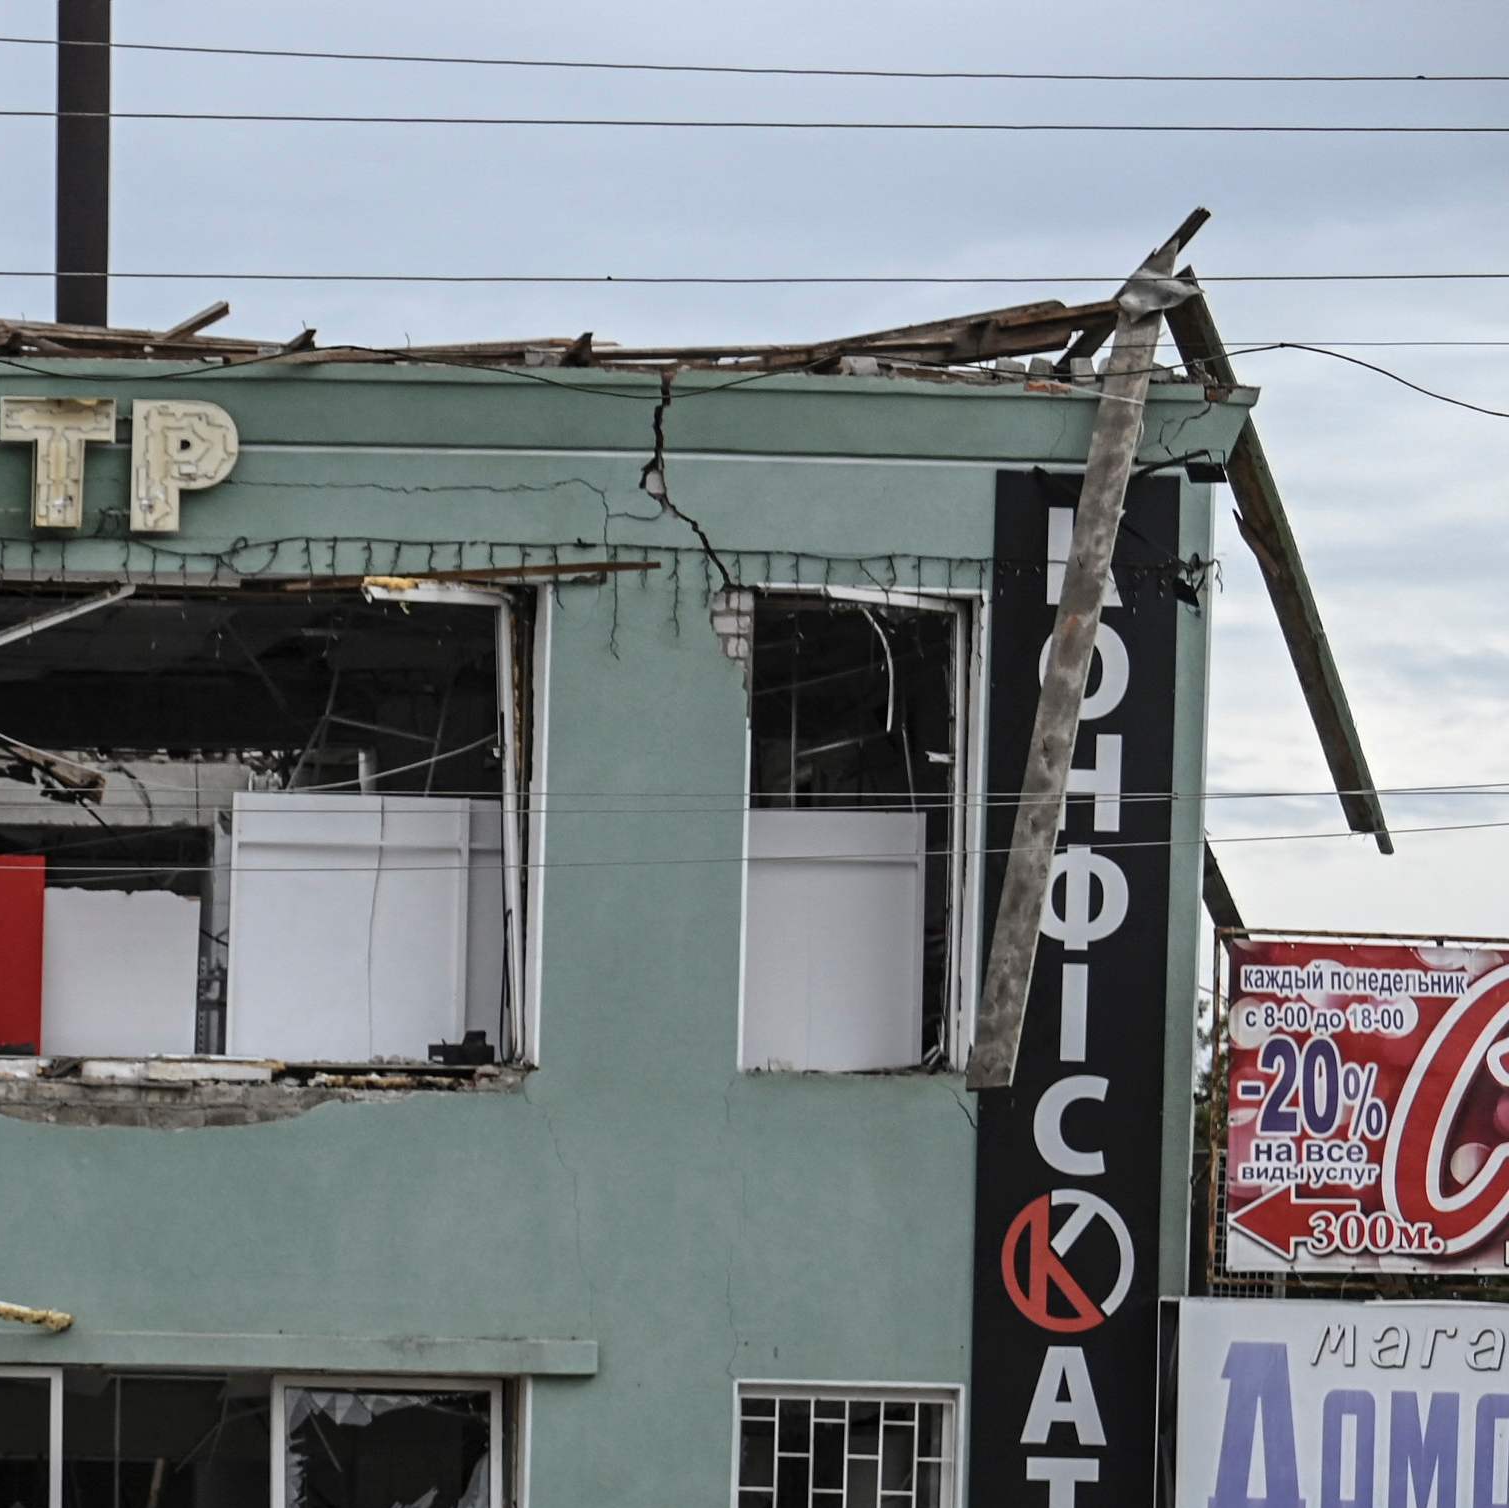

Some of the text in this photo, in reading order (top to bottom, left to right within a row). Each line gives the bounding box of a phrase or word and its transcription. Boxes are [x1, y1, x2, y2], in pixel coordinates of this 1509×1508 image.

[1244, 965, 1465, 996] каждый понедельник
[1246, 1006, 1404, 1032] с 8-00 до 18-00
[1241, 1038, 1383, 1136] -20%
[1254, 1144, 1364, 1163] на все
[1241, 1166, 1378, 1184] виды услуг
[1309, 1215, 1444, 1252] 300м.
